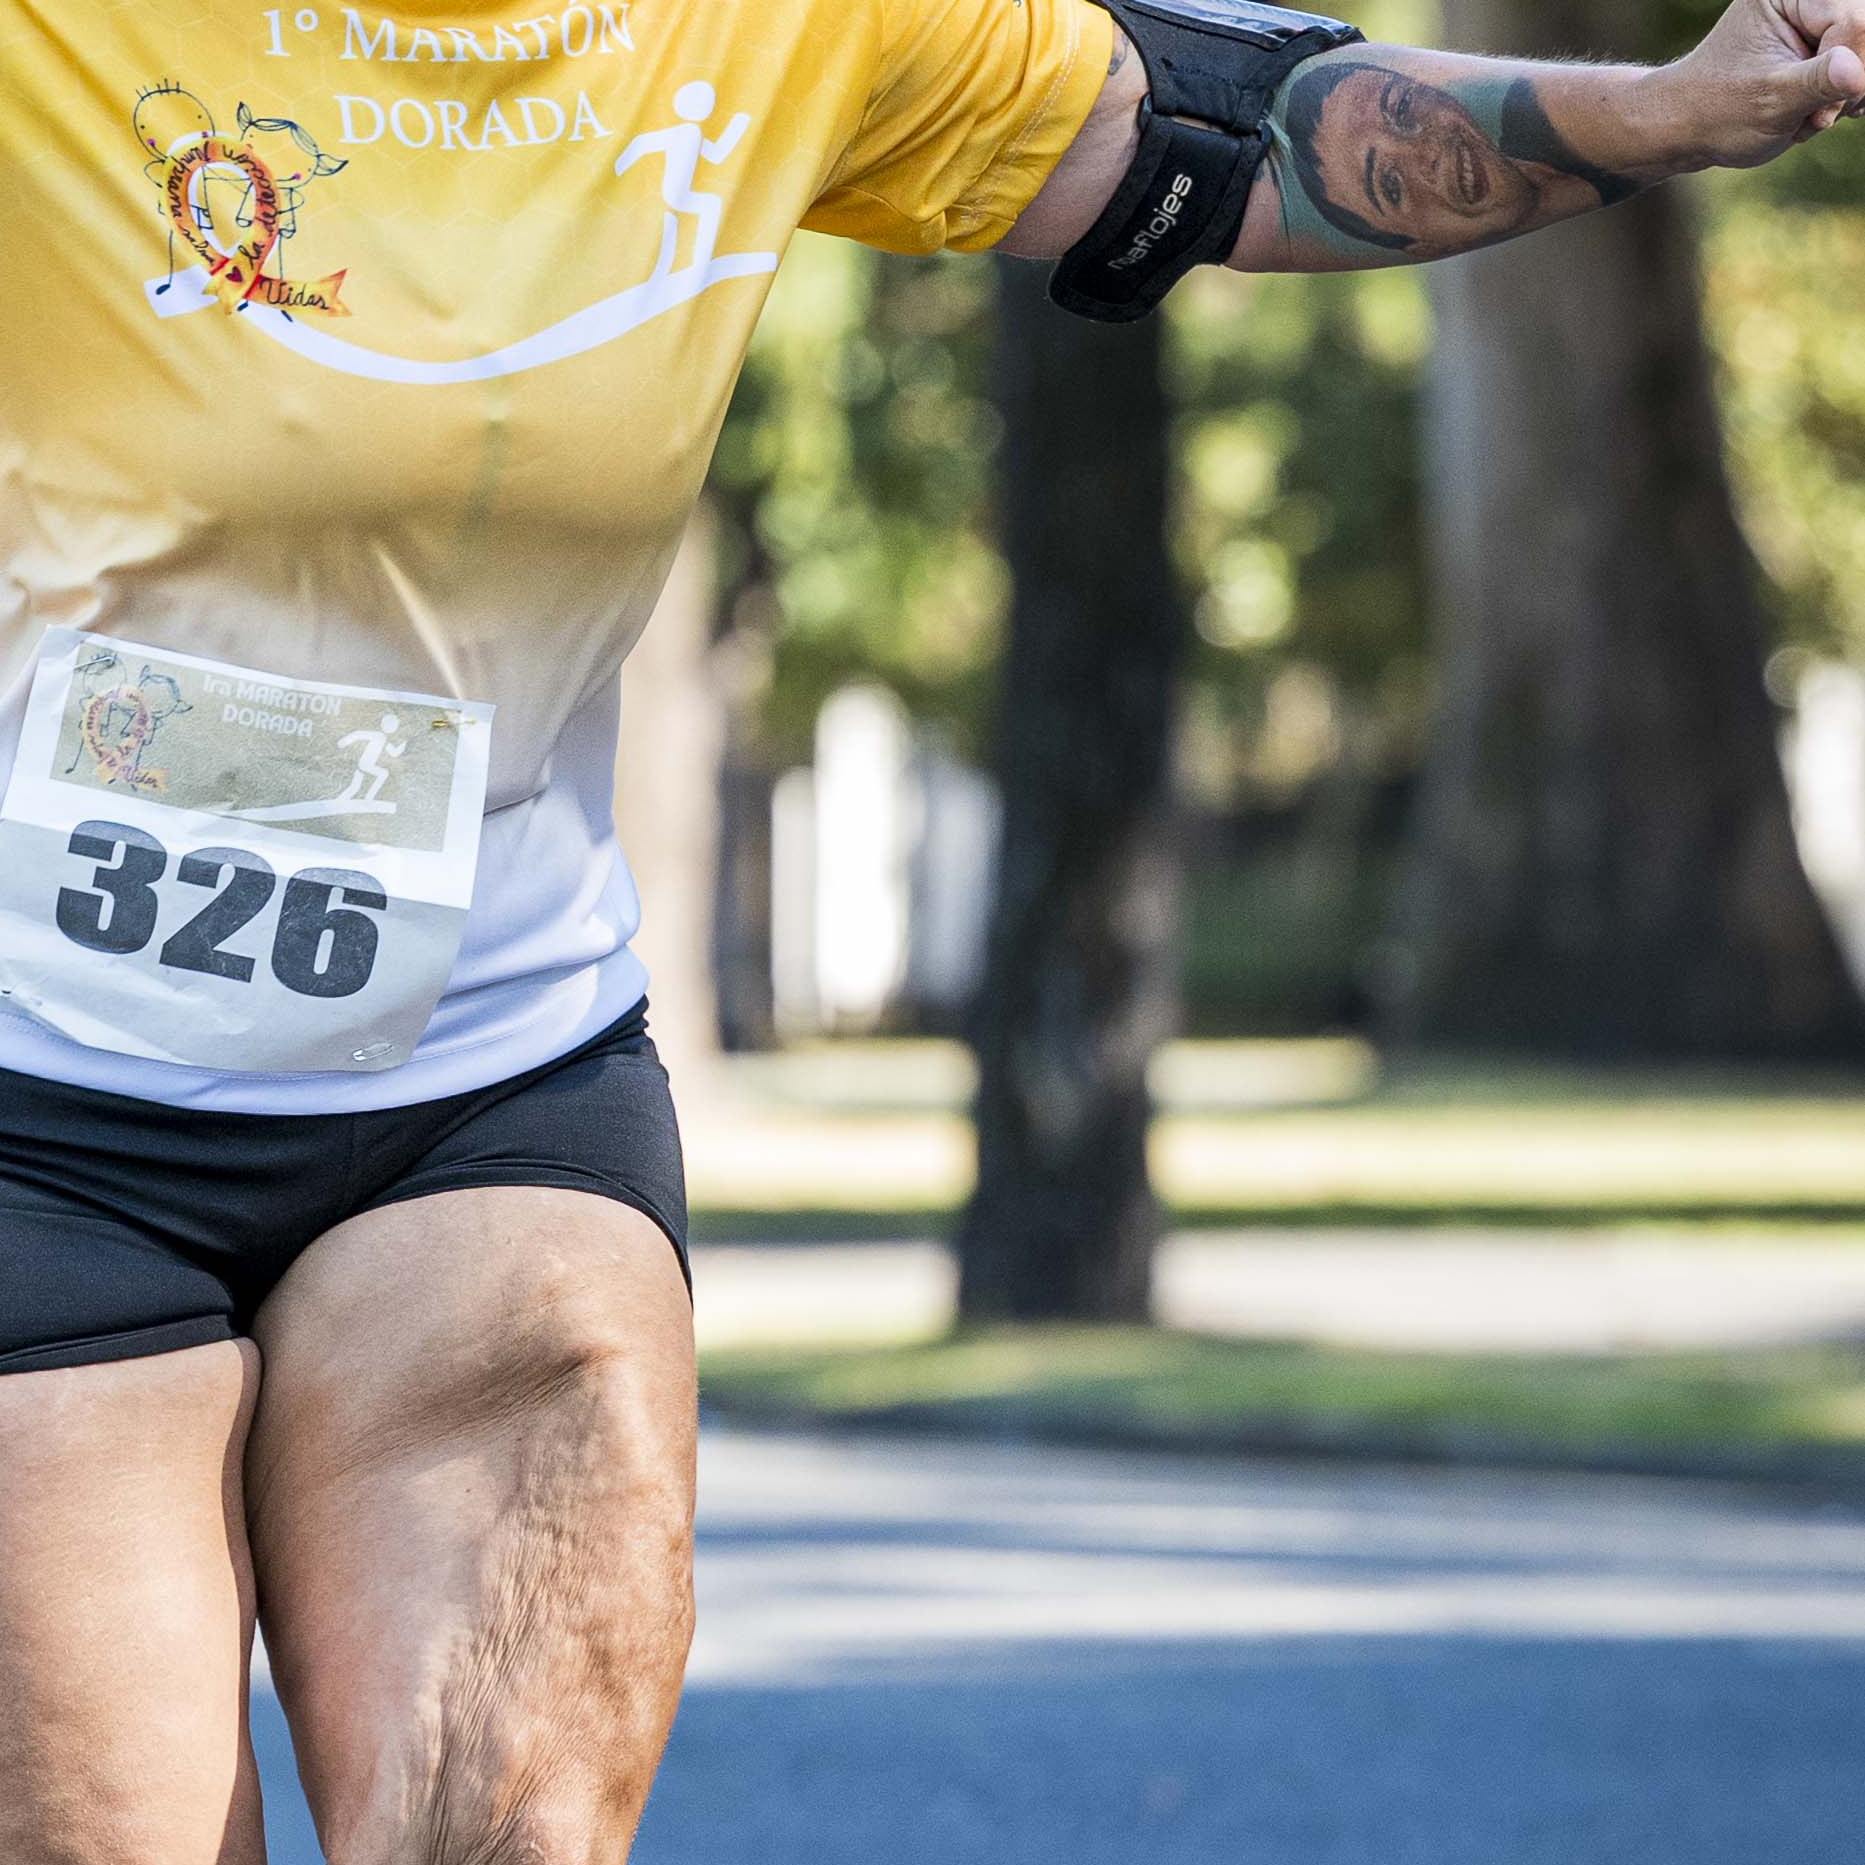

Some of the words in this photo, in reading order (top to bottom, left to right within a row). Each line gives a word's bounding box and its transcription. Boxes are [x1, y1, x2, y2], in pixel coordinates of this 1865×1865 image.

[333, 90, 614, 152] DORADA
[258, 278, 329, 310] Vidas
[222, 703, 313, 737] DORADA
[56, 819, 388, 999] 326
